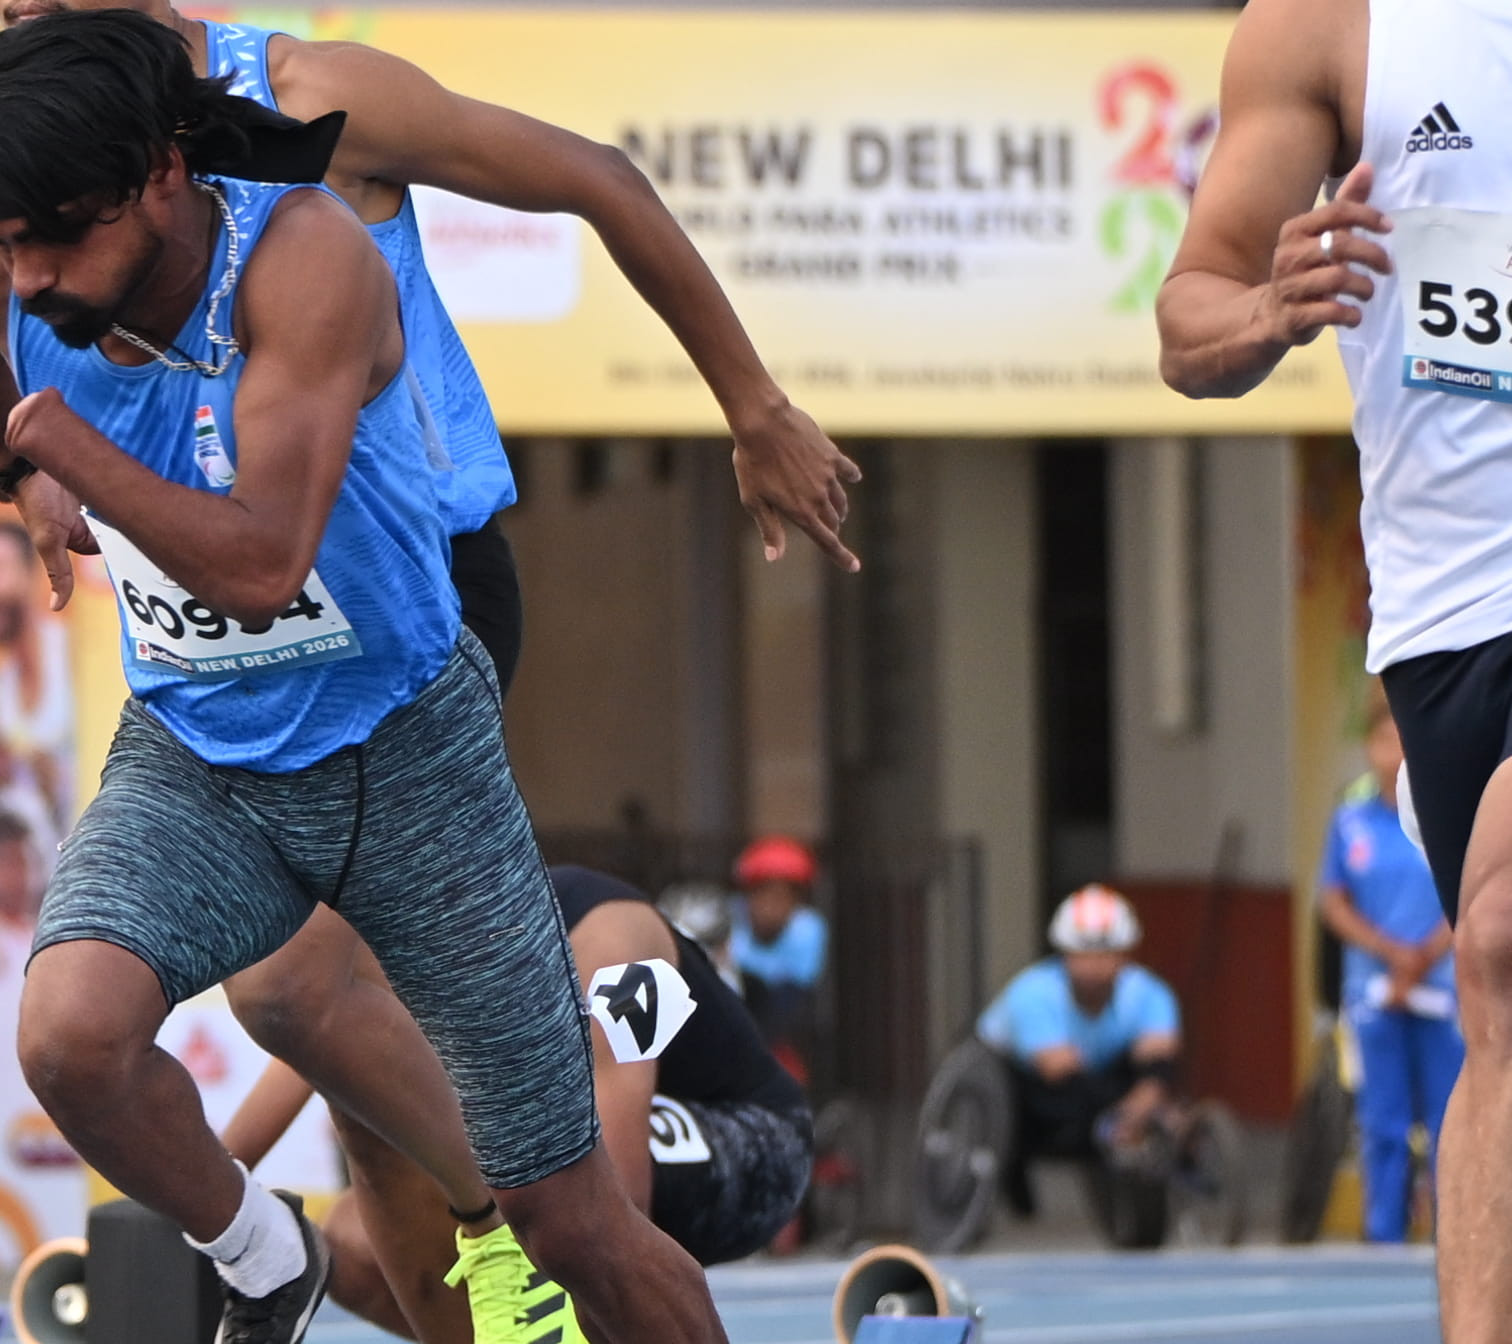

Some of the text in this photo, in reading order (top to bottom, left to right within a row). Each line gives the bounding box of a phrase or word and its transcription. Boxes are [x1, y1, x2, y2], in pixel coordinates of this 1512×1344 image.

[618, 123, 1075, 190] NEW DELHI
[1406, 131, 1473, 154] adidas
[1429, 363, 1491, 387] IndianOil
[122, 579, 325, 641] 6094
[195, 659, 237, 673] NEW
[242, 647, 299, 668] DELHI
[302, 634, 350, 655] 2026
